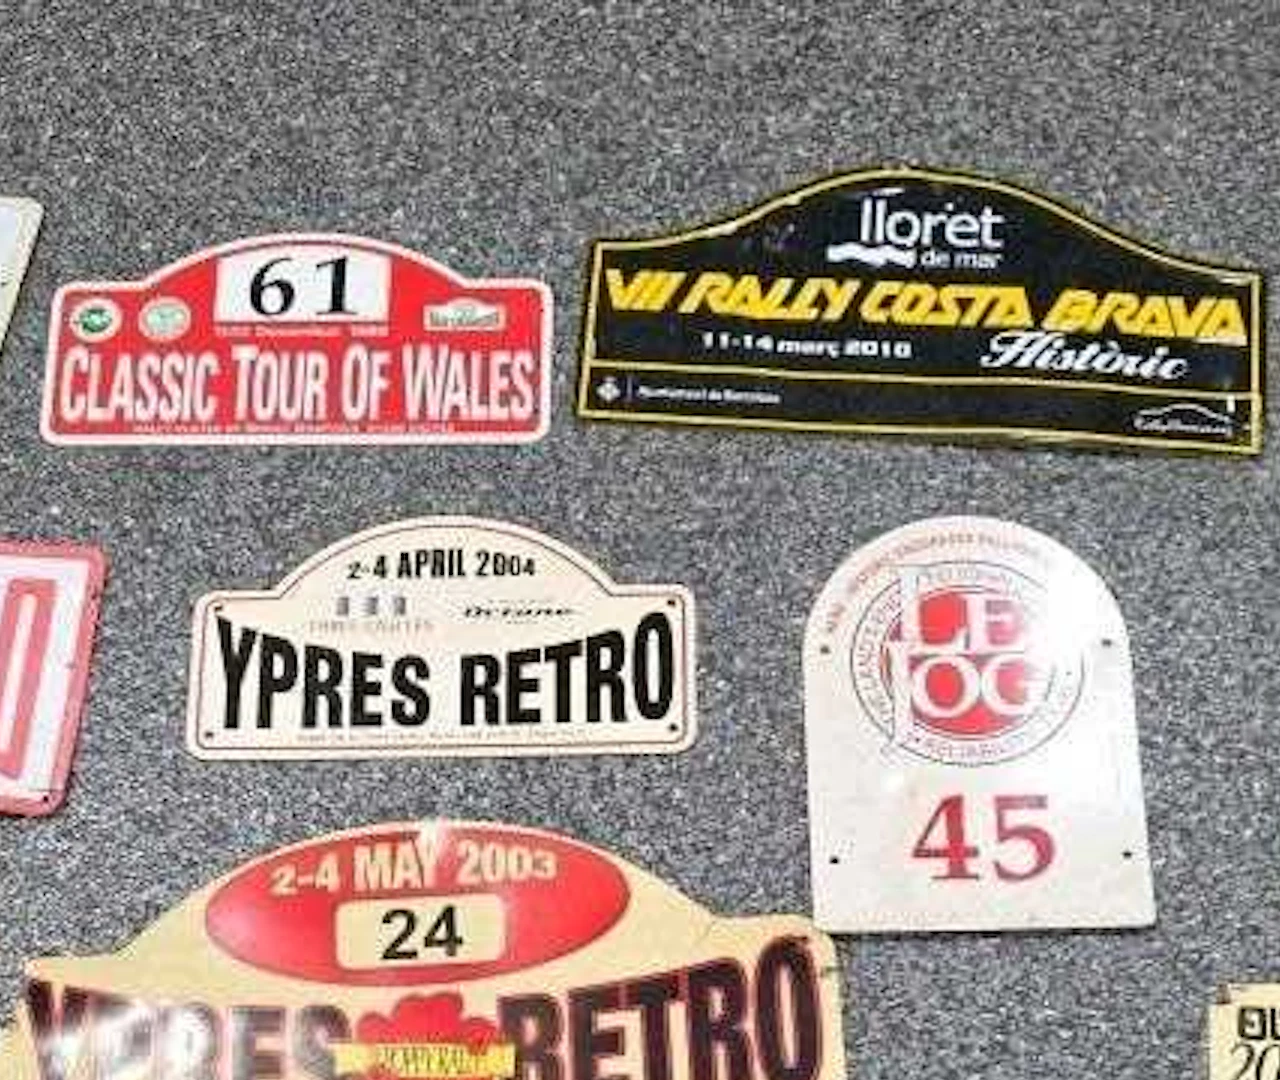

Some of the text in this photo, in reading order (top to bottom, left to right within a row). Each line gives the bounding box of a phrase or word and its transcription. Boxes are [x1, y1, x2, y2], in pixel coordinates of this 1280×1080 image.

[862, 197, 1004, 247] lloret
[249, 255, 360, 316] 61
[920, 250, 1004, 269] de mar
[606, 268, 1247, 346] VII RALLY COSTA BRAVA
[843, 339, 912, 358] 2010
[61, 344, 536, 422] CLASSIC TOUR OF WALES
[397, 549, 466, 579] APRIL
[477, 552, 536, 577] 2004
[217, 613, 674, 729] YPRES RETRO
[911, 795, 1058, 881] 45
[271, 842, 557, 897] 2-4 MAY 2003
[380, 906, 463, 961] 24
